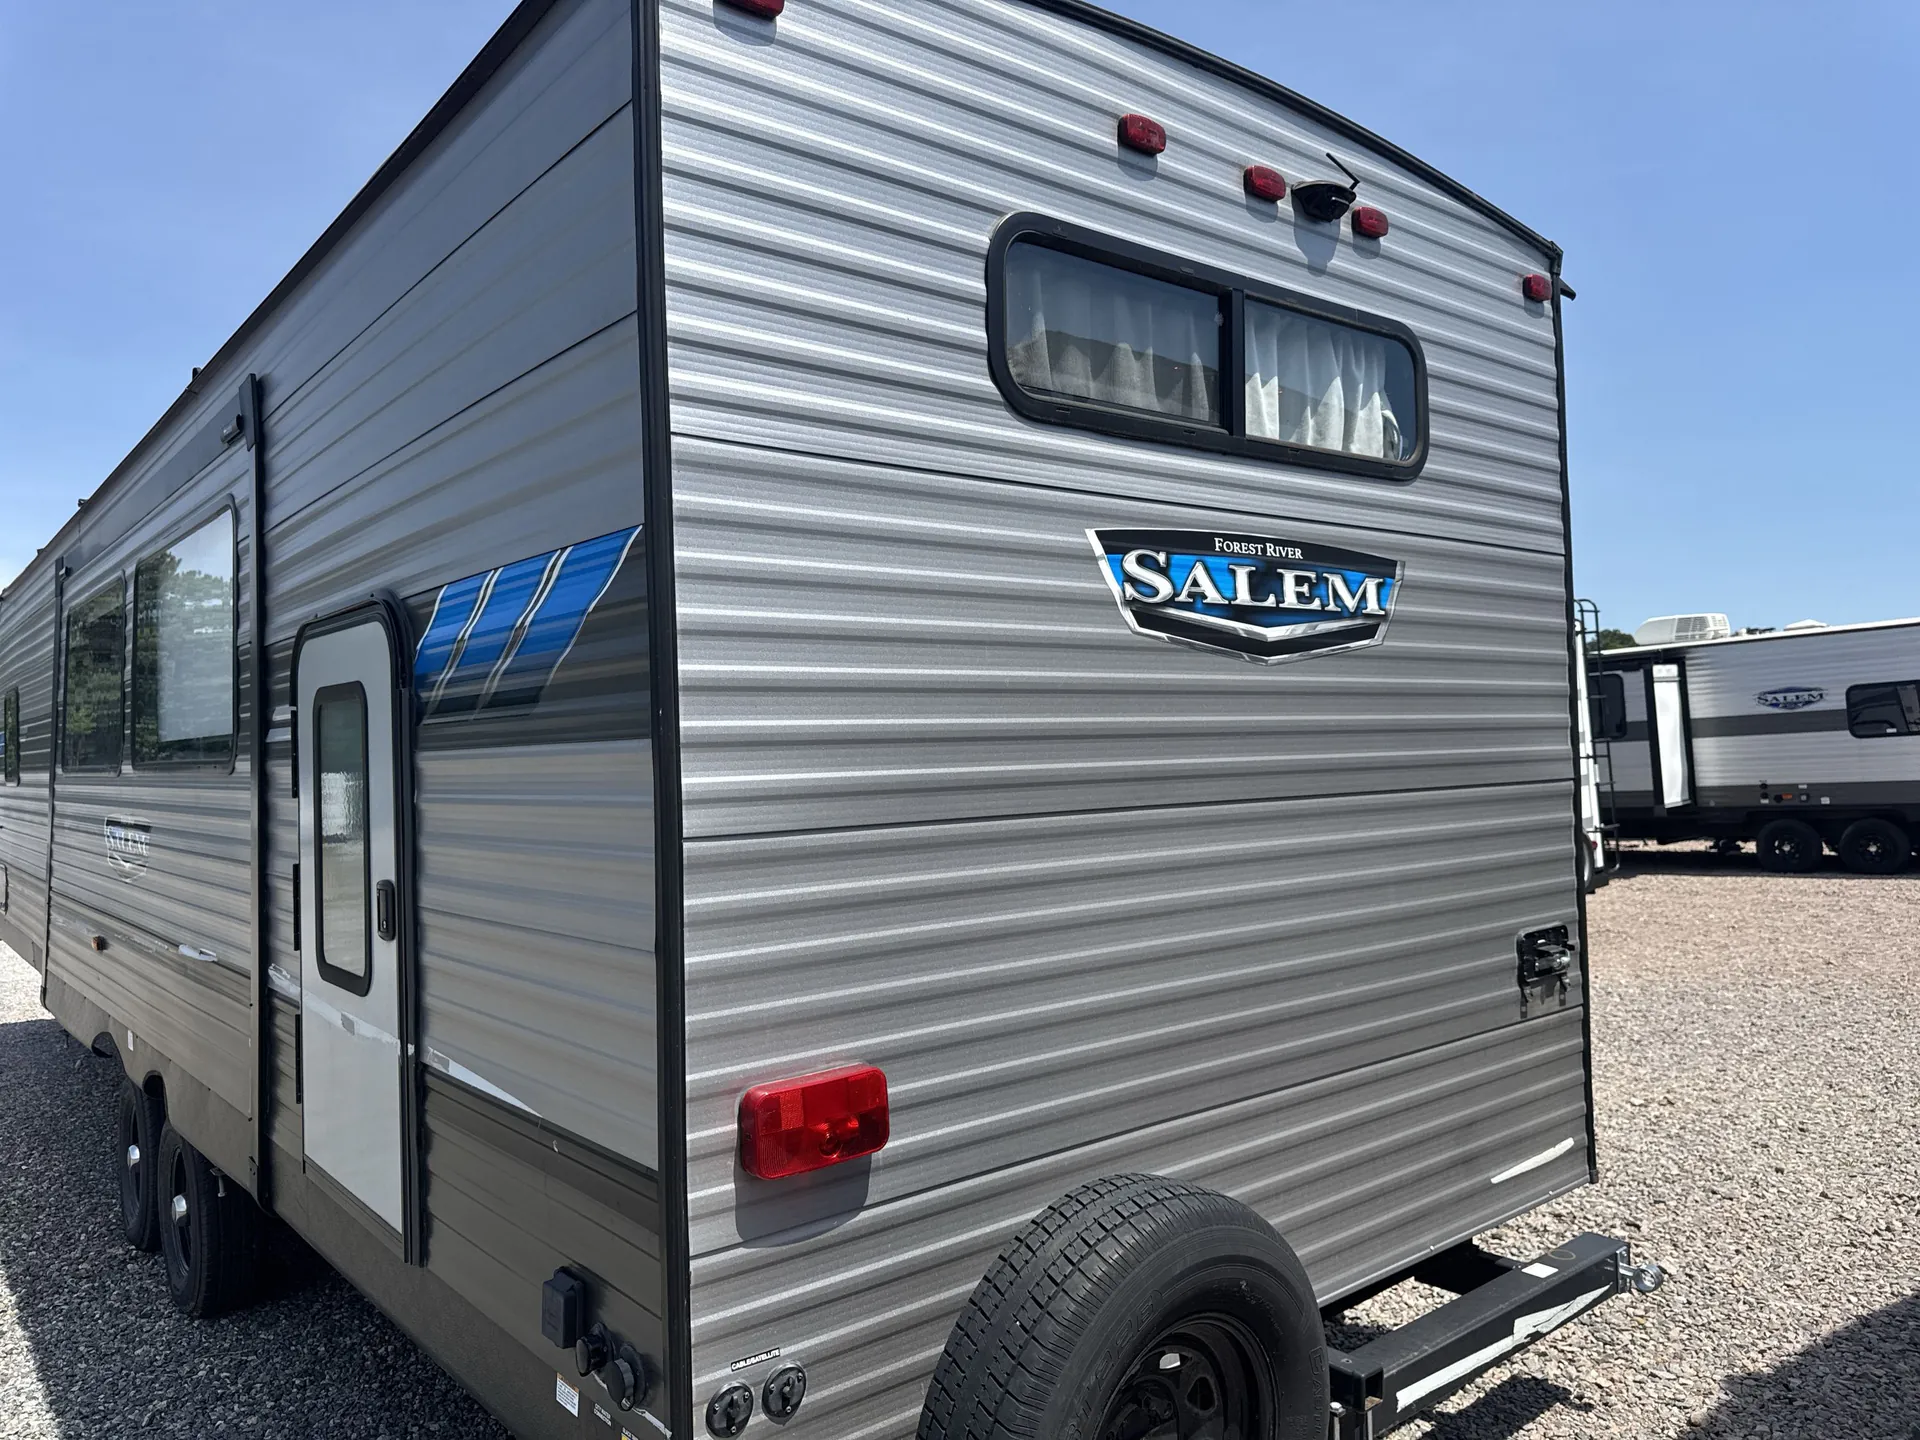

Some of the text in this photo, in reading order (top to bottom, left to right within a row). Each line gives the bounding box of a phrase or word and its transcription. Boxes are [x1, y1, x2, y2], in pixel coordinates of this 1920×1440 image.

[1214, 537, 1303, 559] FOREST RIVER
[1122, 549, 1386, 616] SALEM
[1757, 692, 1824, 703] SALEM
